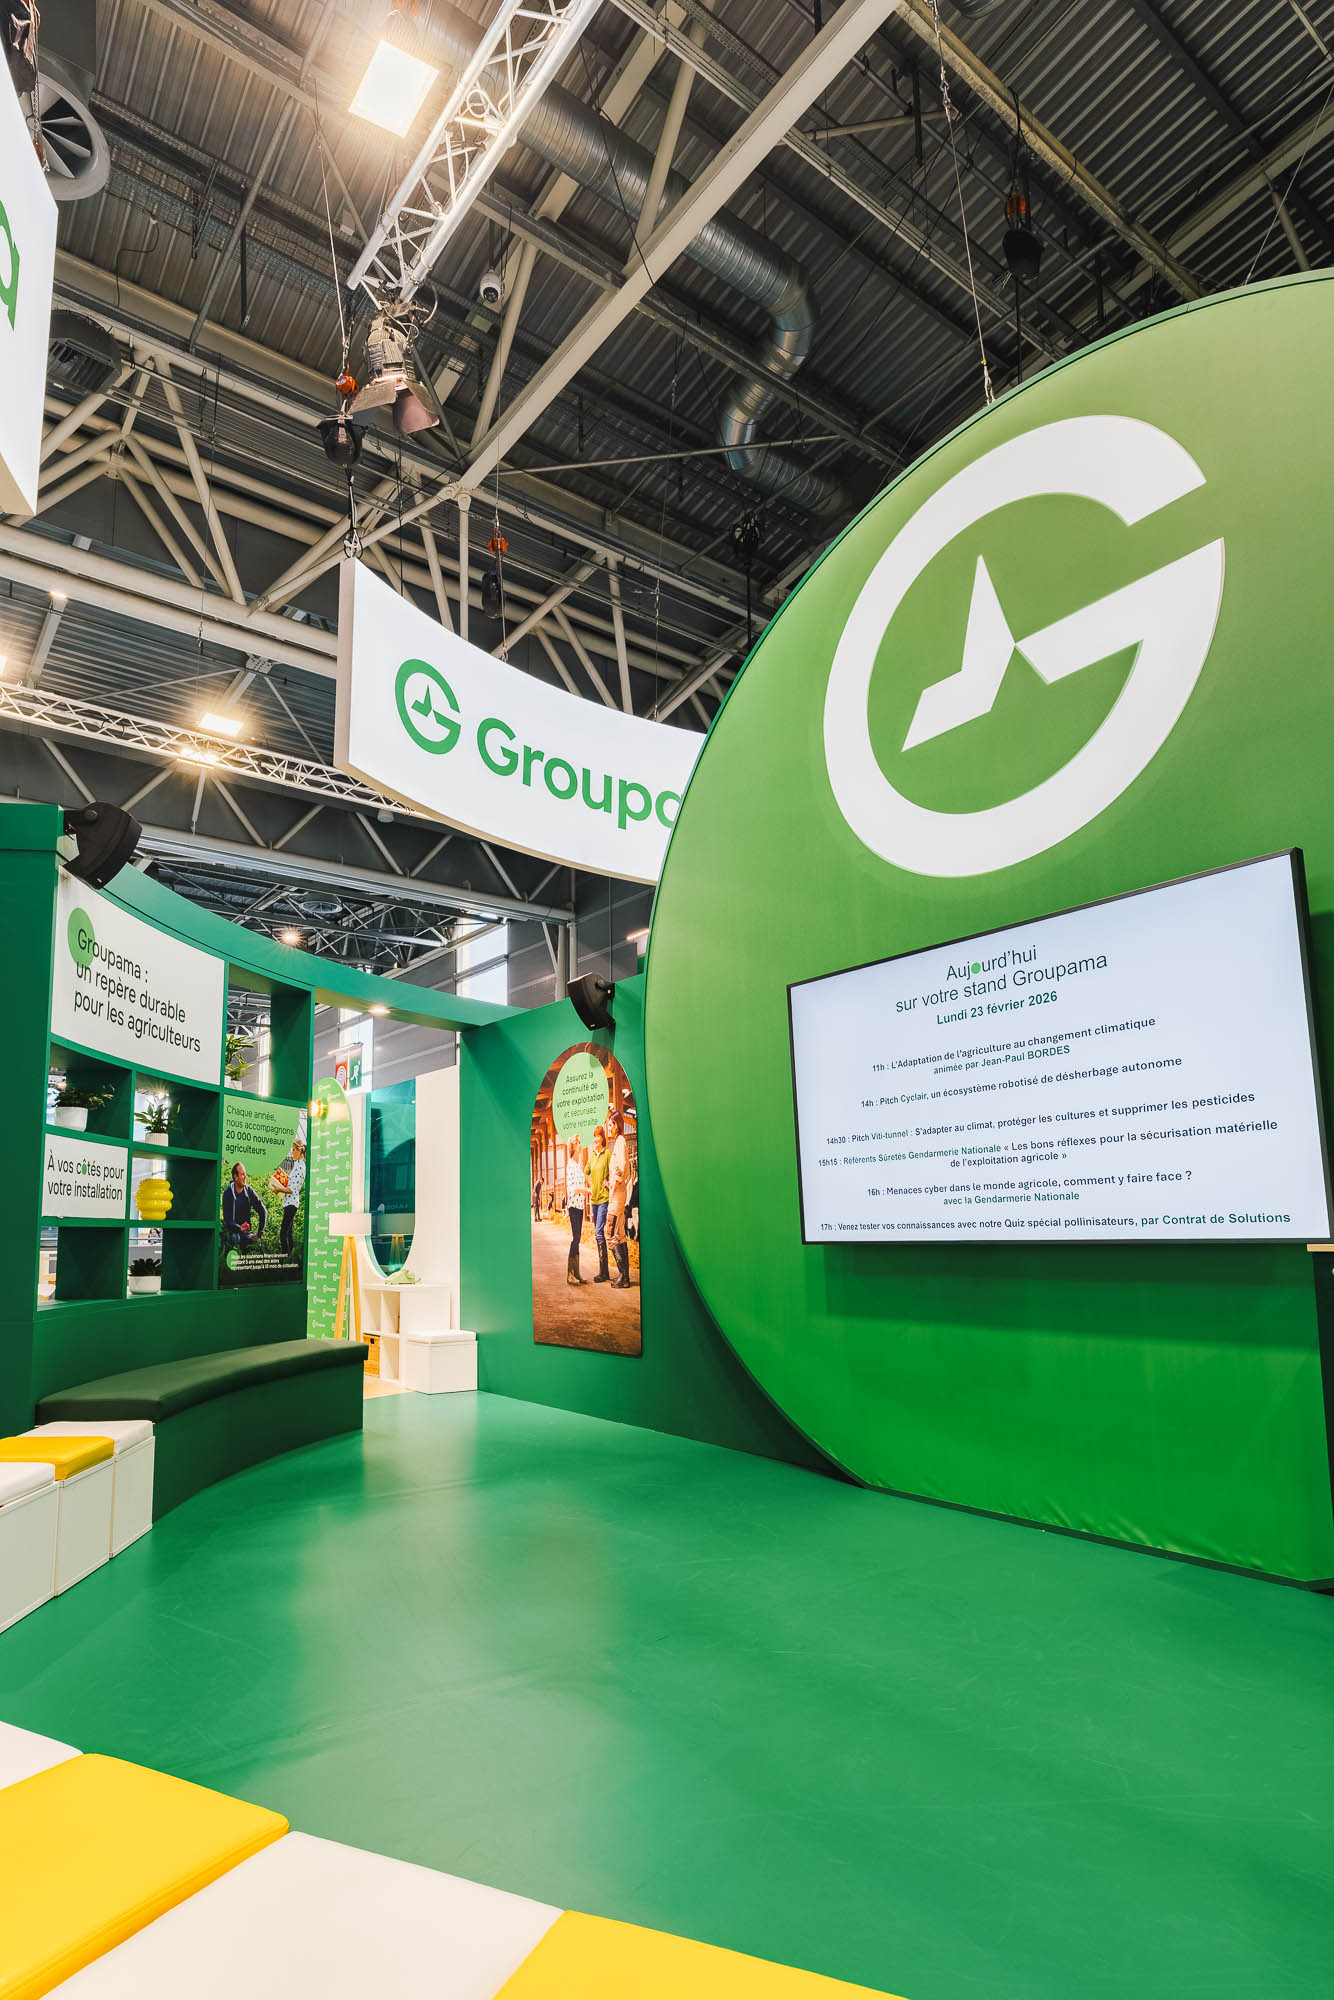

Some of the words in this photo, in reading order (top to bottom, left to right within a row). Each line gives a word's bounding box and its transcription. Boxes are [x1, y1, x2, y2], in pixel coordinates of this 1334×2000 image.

[77, 928, 141, 979] Groupama
[76, 961, 92, 983] un
[96, 971, 136, 1003] repère
[140, 990, 186, 1023] durable
[896, 997, 917, 1012] sur
[921, 989, 958, 1006] votre
[963, 973, 1006, 997] stand
[1012, 955, 1107, 986] Groupama
[74, 990, 103, 1017] pour
[107, 1001, 124, 1026] les
[128, 1015, 201, 1052] agriculteurs
[936, 1009, 967, 1024] Lundi
[970, 1006, 983, 1018] 23
[986, 999, 1024, 1014] février
[1028, 990, 1057, 1006] 2026
[891, 1055, 942, 1069] L'Adaptation
[944, 1052, 954, 1060] de
[956, 1043, 1011, 1058] l'agriculture
[1013, 1040, 1025, 1048] au
[1027, 1028, 1091, 1046] changement
[1094, 1018, 1155, 1035] climatique
[933, 1063, 963, 1074] animée
[965, 1061, 979, 1071] par
[981, 1052, 1024, 1066] Jean-Paul
[1027, 1044, 1070, 1059] BORDES
[879, 1096, 898, 1105] Pitch
[900, 1092, 928, 1103] Cyclair,
[943, 1083, 996, 1096] écosystème
[998, 1075, 1038, 1089] robotisé
[1040, 1074, 1053, 1083] de
[1055, 1066, 1118, 1081] désherbage
[1121, 1058, 1181, 1072] autonome
[226, 1105, 252, 1118] Chaque
[557, 1099, 570, 1108] votre
[572, 1093, 604, 1106] exploitation
[226, 1119, 243, 1128] nous
[245, 1122, 294, 1135] accompagnons
[827, 1136, 846, 1144] 14h30
[851, 1133, 869, 1142] Pitch
[915, 1126, 952, 1135] S'adapter
[966, 1120, 995, 1130] climat,
[997, 1116, 1036, 1129] protéger
[1038, 1114, 1052, 1123] les
[1055, 1111, 1095, 1121] cultures
[1098, 1108, 1108, 1116] et
[1111, 1103, 1168, 1116] supprimer
[1171, 1100, 1188, 1109] les
[1192, 1093, 1255, 1109] pesticides
[226, 1130, 235, 1139] 20
[237, 1131, 251, 1141] 000
[253, 1135, 285, 1146] nouveaux
[226, 1143, 266, 1155] agriculteurs
[818, 1158, 837, 1166] 15h15
[908, 1147, 958, 1159] Gendarmerie
[961, 1144, 1001, 1154] Nationale
[1011, 1142, 1028, 1150] Les
[1030, 1140, 1054, 1149] bons
[1057, 1137, 1096, 1146] réflexes
[1099, 1134, 1124, 1145] pour
[1127, 1132, 1136, 1141] la
[1140, 1126, 1211, 1140] sécurisation
[1215, 1119, 1277, 1133] matérielle
[47, 1148, 55, 1171] À
[57, 1159, 73, 1173] vos
[76, 1158, 101, 1177] côtés
[103, 1166, 124, 1181] pour
[950, 1159, 960, 1167] de
[962, 1155, 1018, 1167] l'exploitation
[1021, 1151, 1058, 1164] agricole
[48, 1180, 72, 1196] votre
[74, 1180, 123, 1200] installation
[868, 1188, 880, 1196] 16h
[924, 1185, 947, 1195] cyber
[949, 1184, 970, 1192] dans
[972, 1182, 981, 1190] le
[983, 1180, 1015, 1190] monde
[1018, 1178, 1060, 1190] agricole,
[1063, 1175, 1115, 1186] comment
[1118, 1176, 1124, 1185] y
[1126, 1173, 1152, 1183] faire
[1155, 1172, 1182, 1181] face
[1185, 1170, 1191, 1179] ?
[964, 1196, 972, 1204] la
[974, 1193, 1031, 1203] Gendarmerie
[1034, 1191, 1079, 1201] Nationale
[896, 1221, 955, 1229] connaissances
[1004, 1218, 1025, 1227] Quiz
[1027, 1217, 1061, 1228] spécial
[1064, 1217, 1137, 1228] pollinisateurs,
[1141, 1217, 1159, 1227] par
[1162, 1215, 1206, 1224] Contrat
[1209, 1214, 1224, 1223] de
[1228, 1212, 1290, 1223] Solutions
